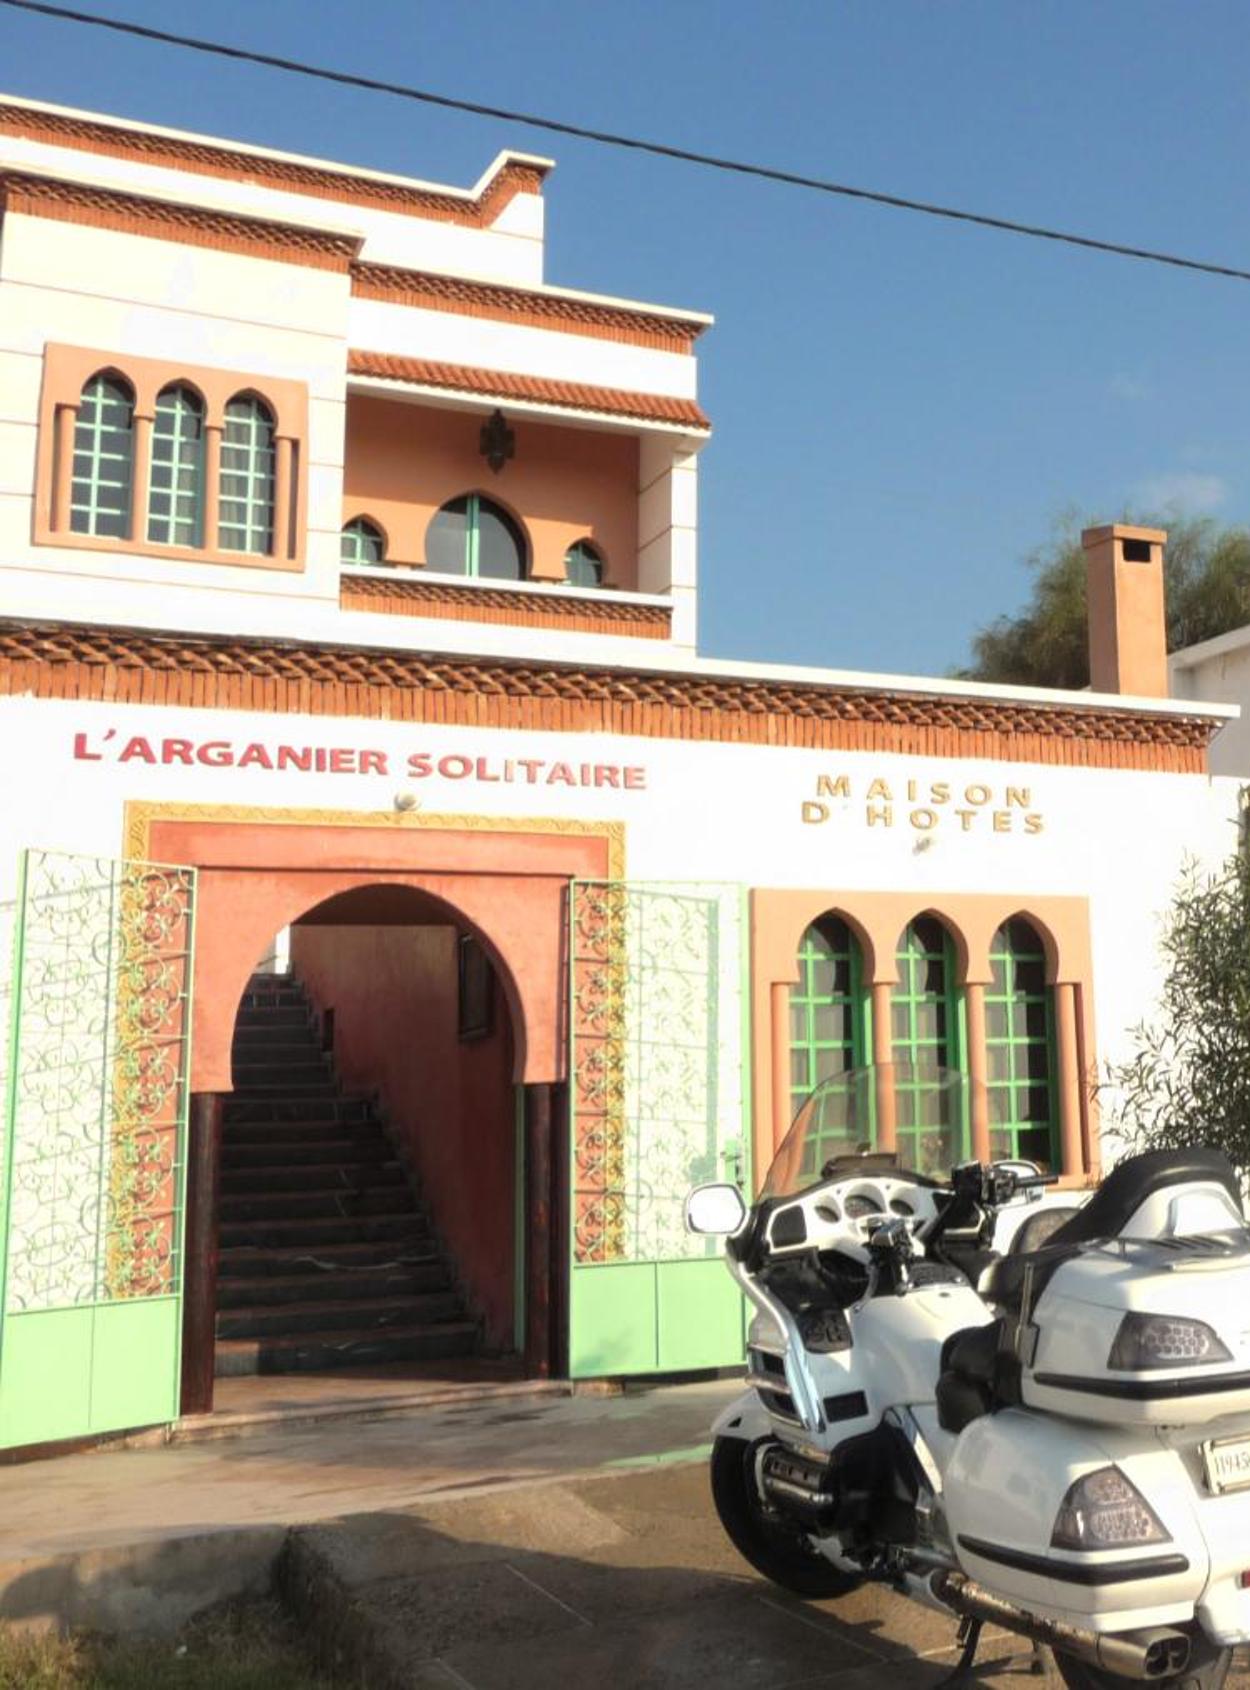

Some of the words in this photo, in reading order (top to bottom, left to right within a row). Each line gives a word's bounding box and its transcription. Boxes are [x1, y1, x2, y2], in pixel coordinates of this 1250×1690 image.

[73, 729, 388, 776] L'ARGANIER
[407, 752, 647, 790] SOLITAIRE
[816, 774, 1032, 808] MAISON
